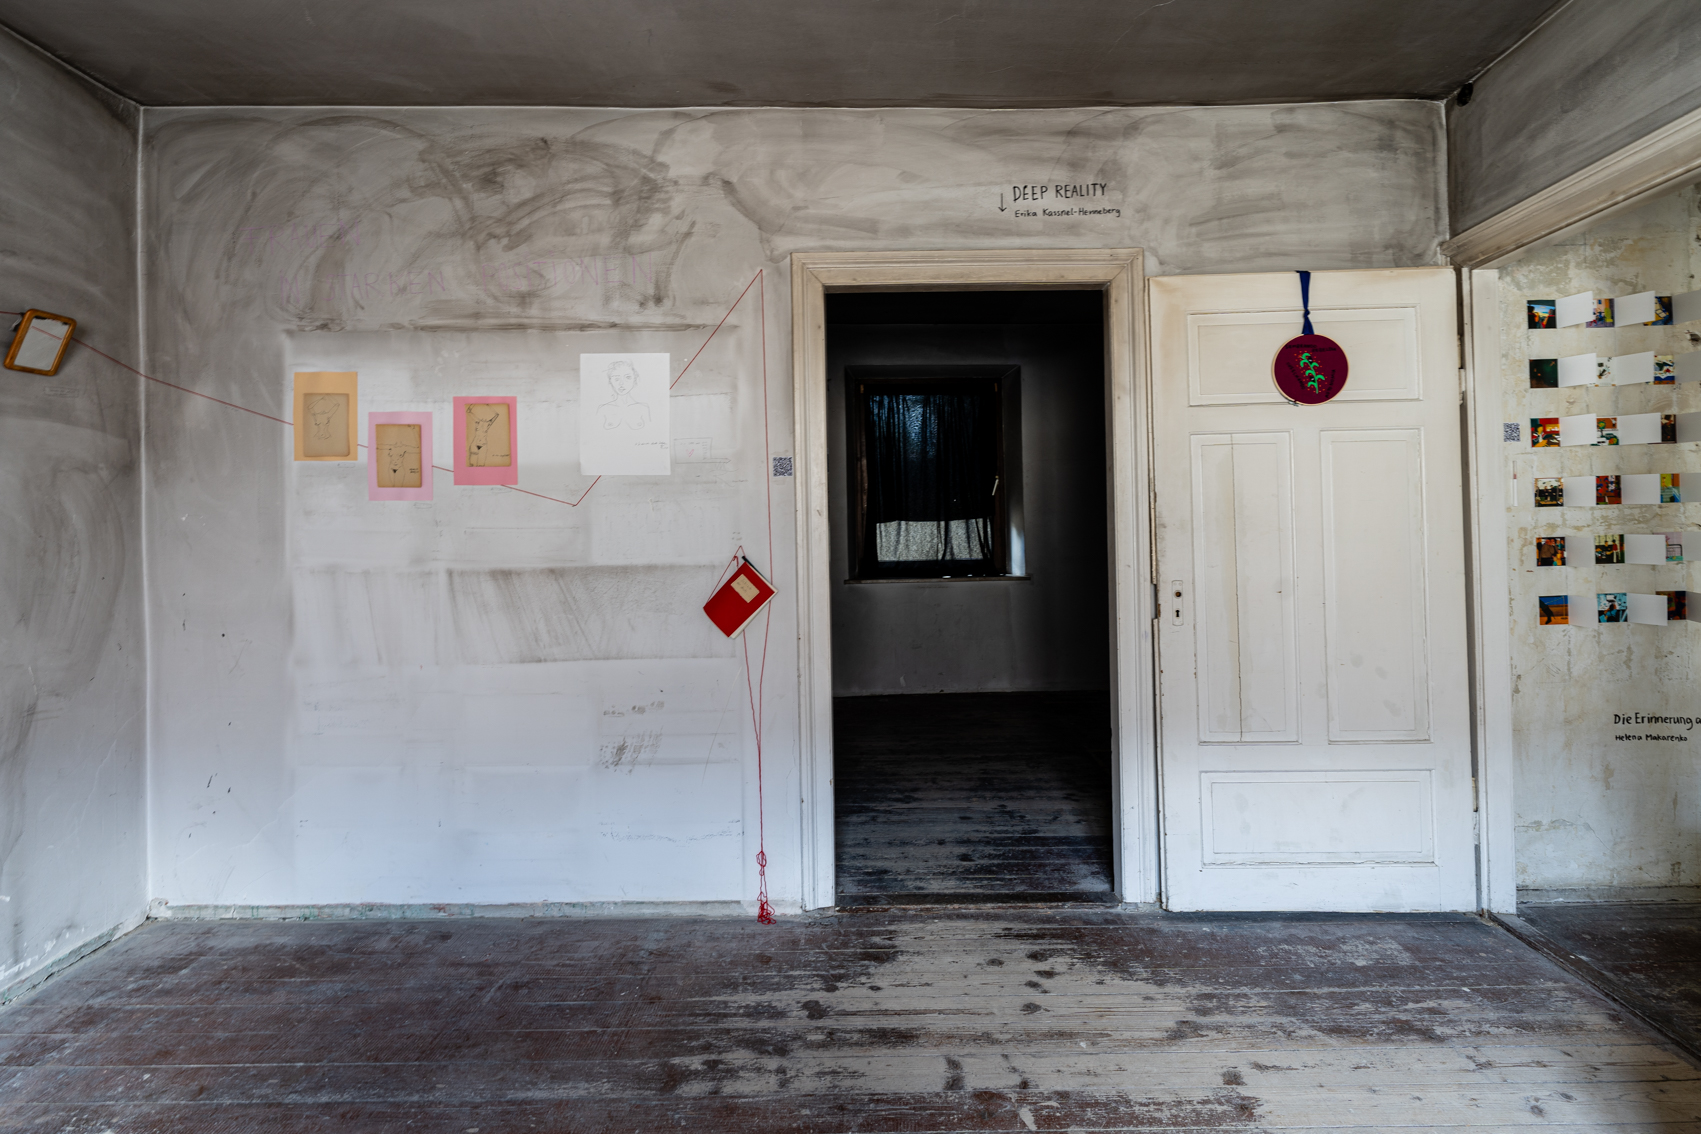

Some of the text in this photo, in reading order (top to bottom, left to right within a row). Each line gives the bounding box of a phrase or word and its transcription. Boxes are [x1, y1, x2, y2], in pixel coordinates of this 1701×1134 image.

[1013, 182, 1108, 203] DEEP REALITY
[1014, 209, 1038, 218] Erika
[238, 217, 361, 257] FRAUEN
[279, 267, 303, 307] IN
[319, 269, 447, 302] STARKEN
[1613, 713, 1632, 725] Die
[1634, 711, 1694, 731] Erinnerung
[1615, 733, 1688, 742] Helena Makarenko
